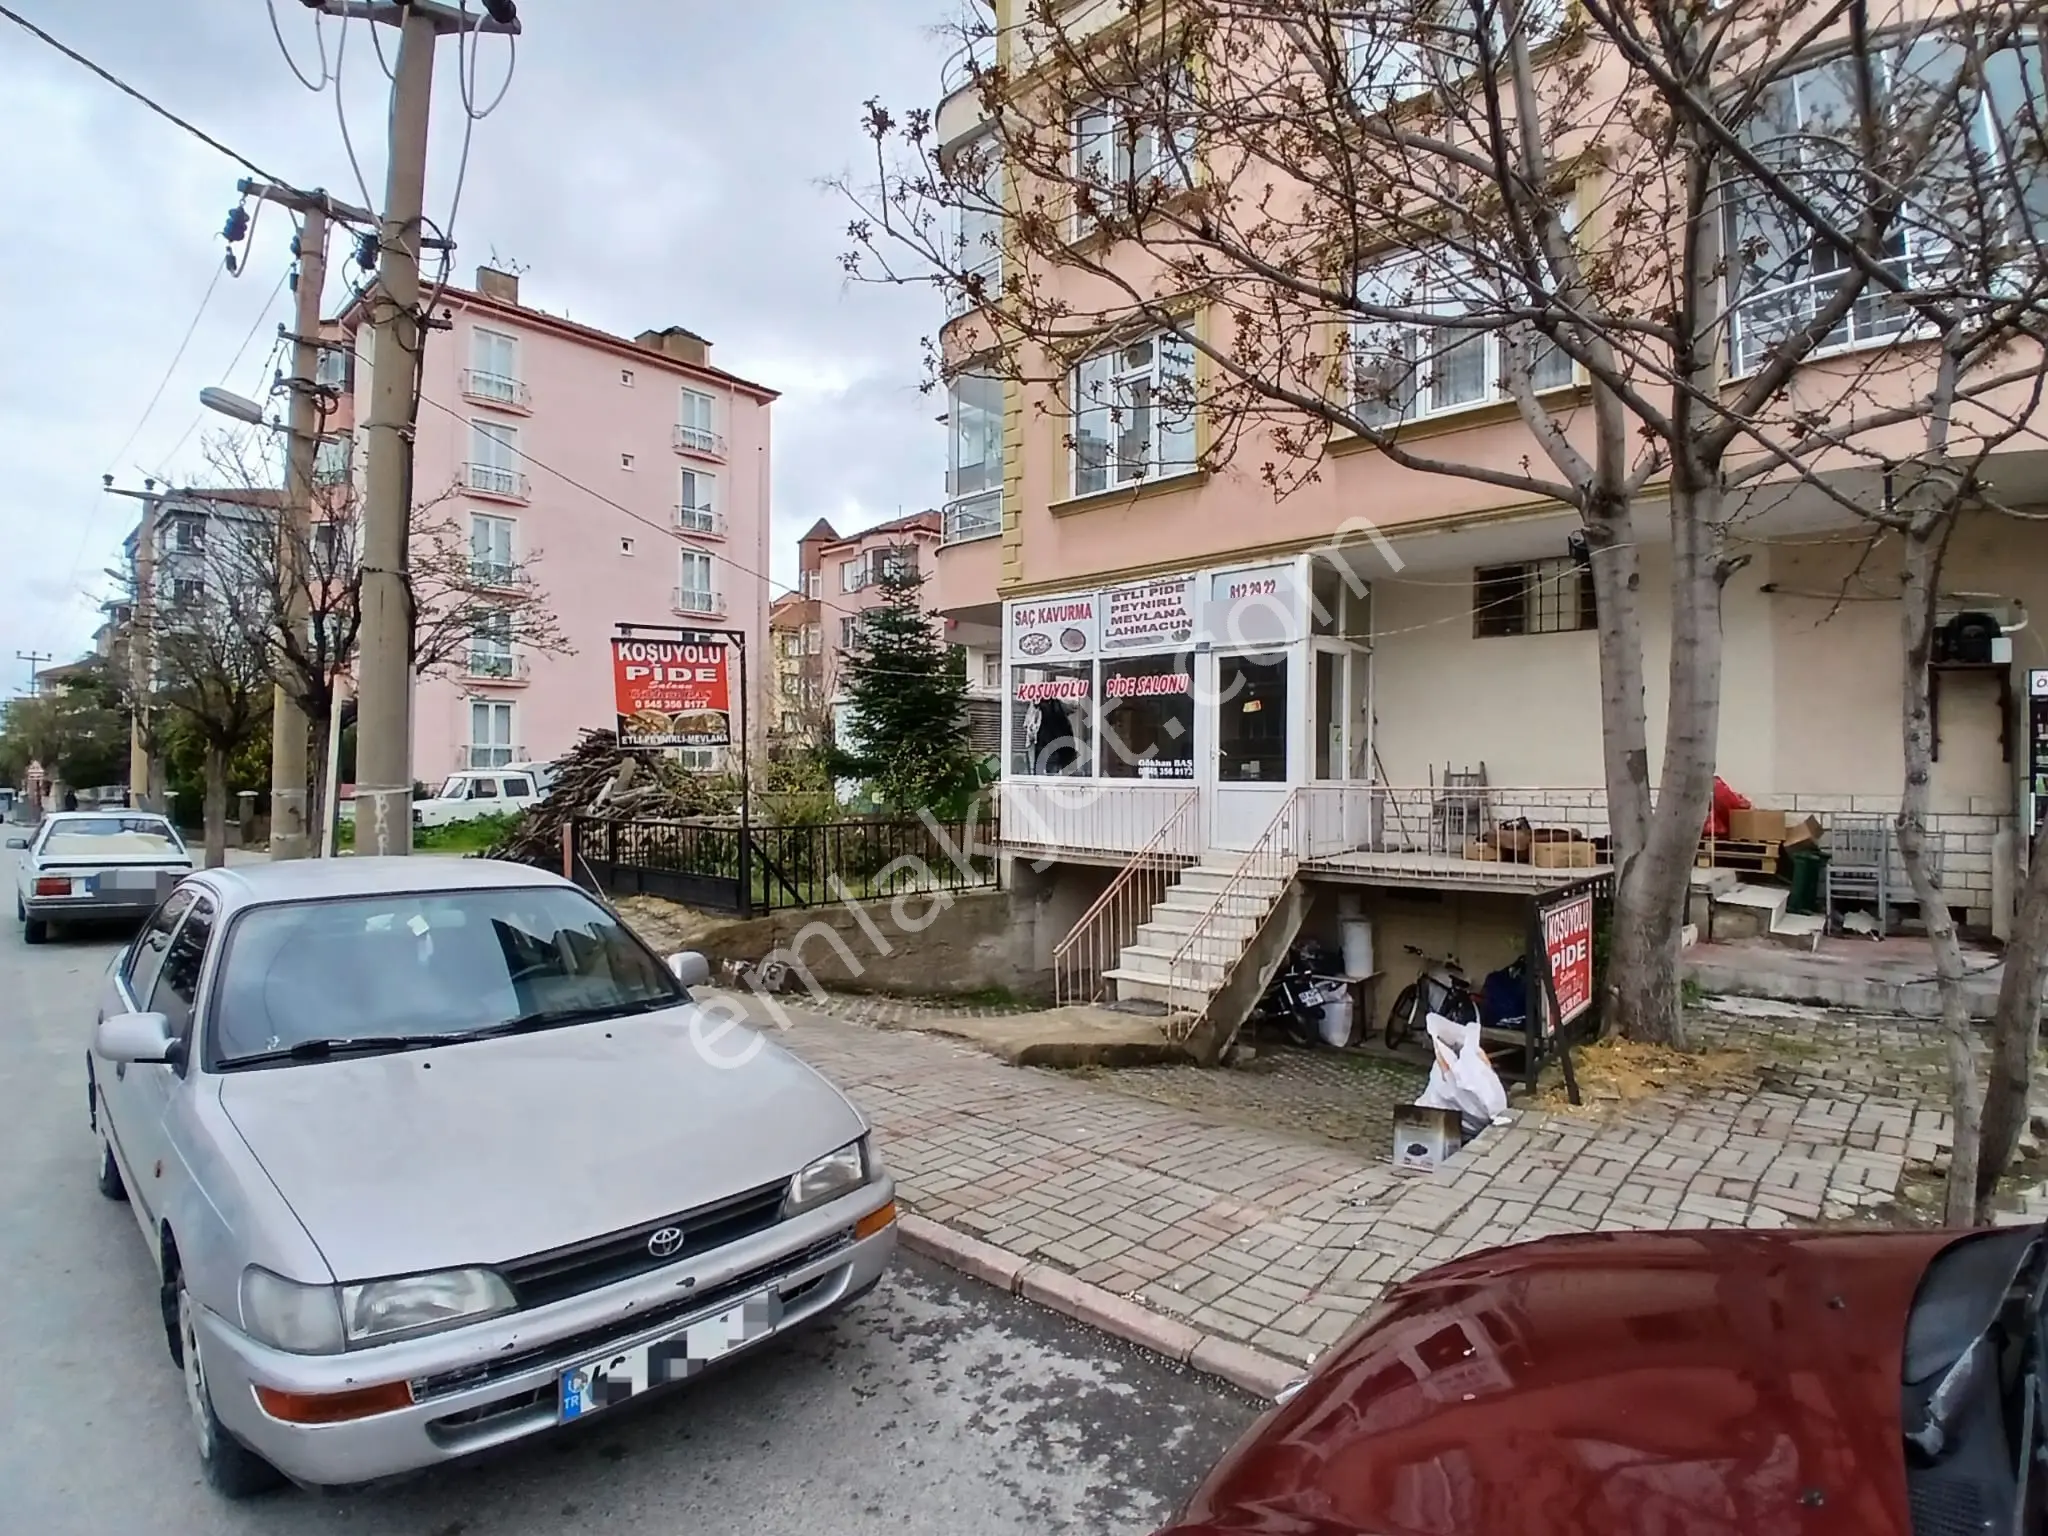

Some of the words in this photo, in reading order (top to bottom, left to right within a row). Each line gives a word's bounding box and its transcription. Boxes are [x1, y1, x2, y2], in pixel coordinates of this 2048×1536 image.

[1015, 610, 1036, 628] SAÇ
[1038, 603, 1093, 624] KAVURMA
[1111, 608, 1187, 625] MEVLANA
[1105, 619, 1193, 637] LAHMACUN
[618, 642, 721, 665] KOŞUYOLU
[626, 663, 718, 682] PİDE
[1017, 680, 1090, 703] KOŞUYOLU
[1106, 674, 1134, 697] PİDE
[1135, 673, 1189, 697] SALONU
[1551, 938, 1587, 978] PİDE
[563, 1395, 579, 1410] TR
